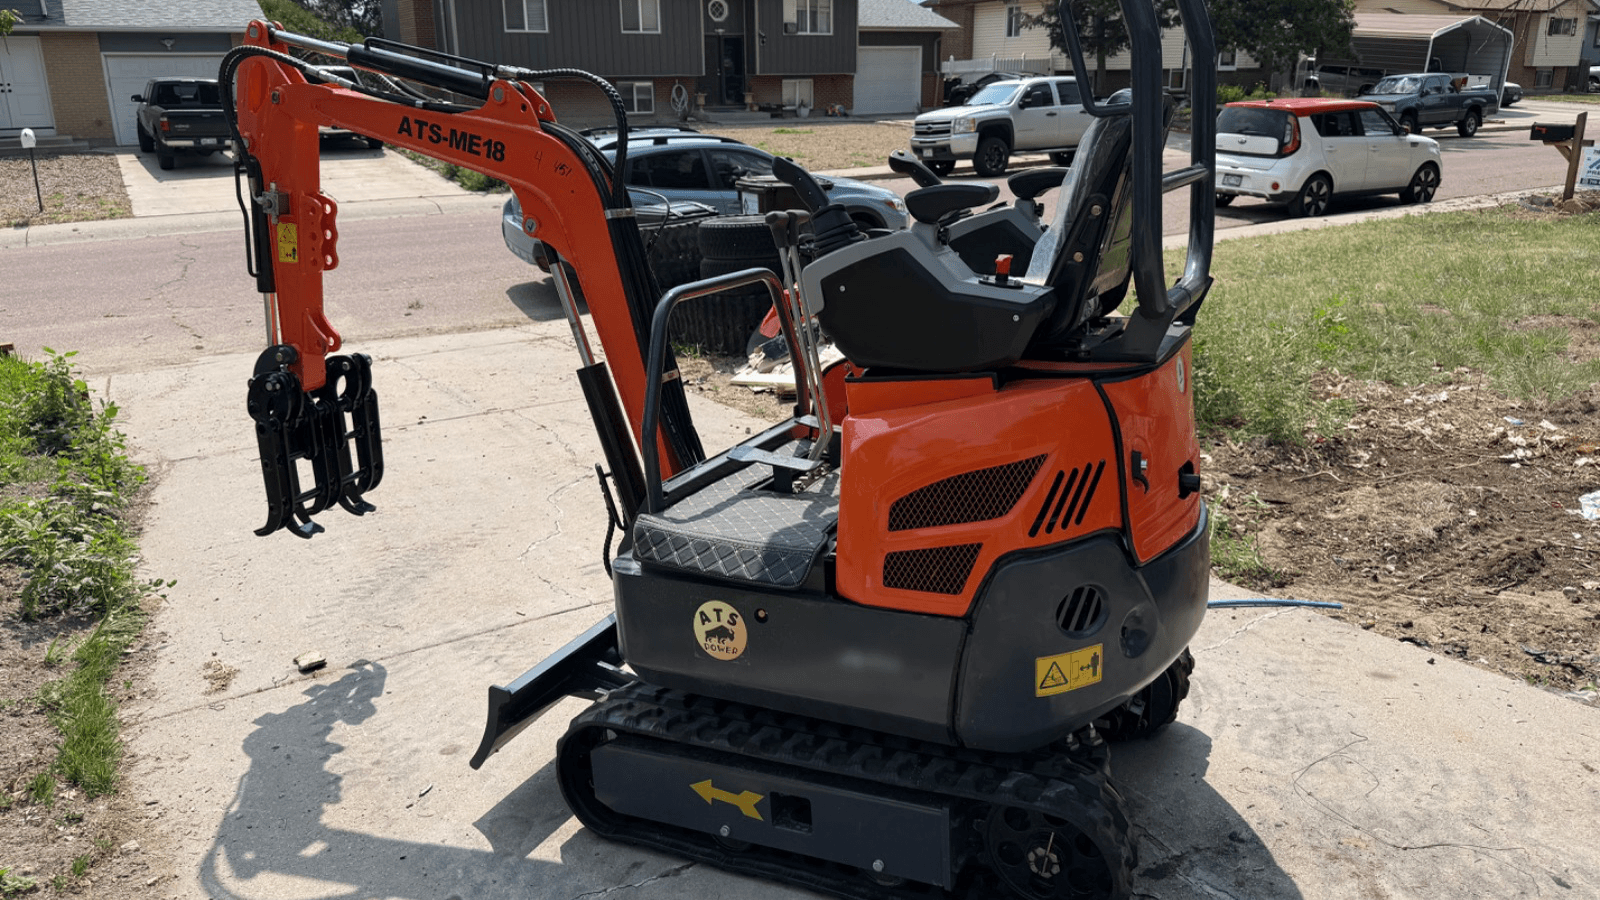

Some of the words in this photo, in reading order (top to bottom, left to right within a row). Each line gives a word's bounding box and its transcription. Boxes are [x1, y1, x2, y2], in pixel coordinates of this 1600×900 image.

[397, 115, 505, 162] ATS-ME18
[699, 608, 739, 626] ATS
[703, 642, 738, 655] POWER
